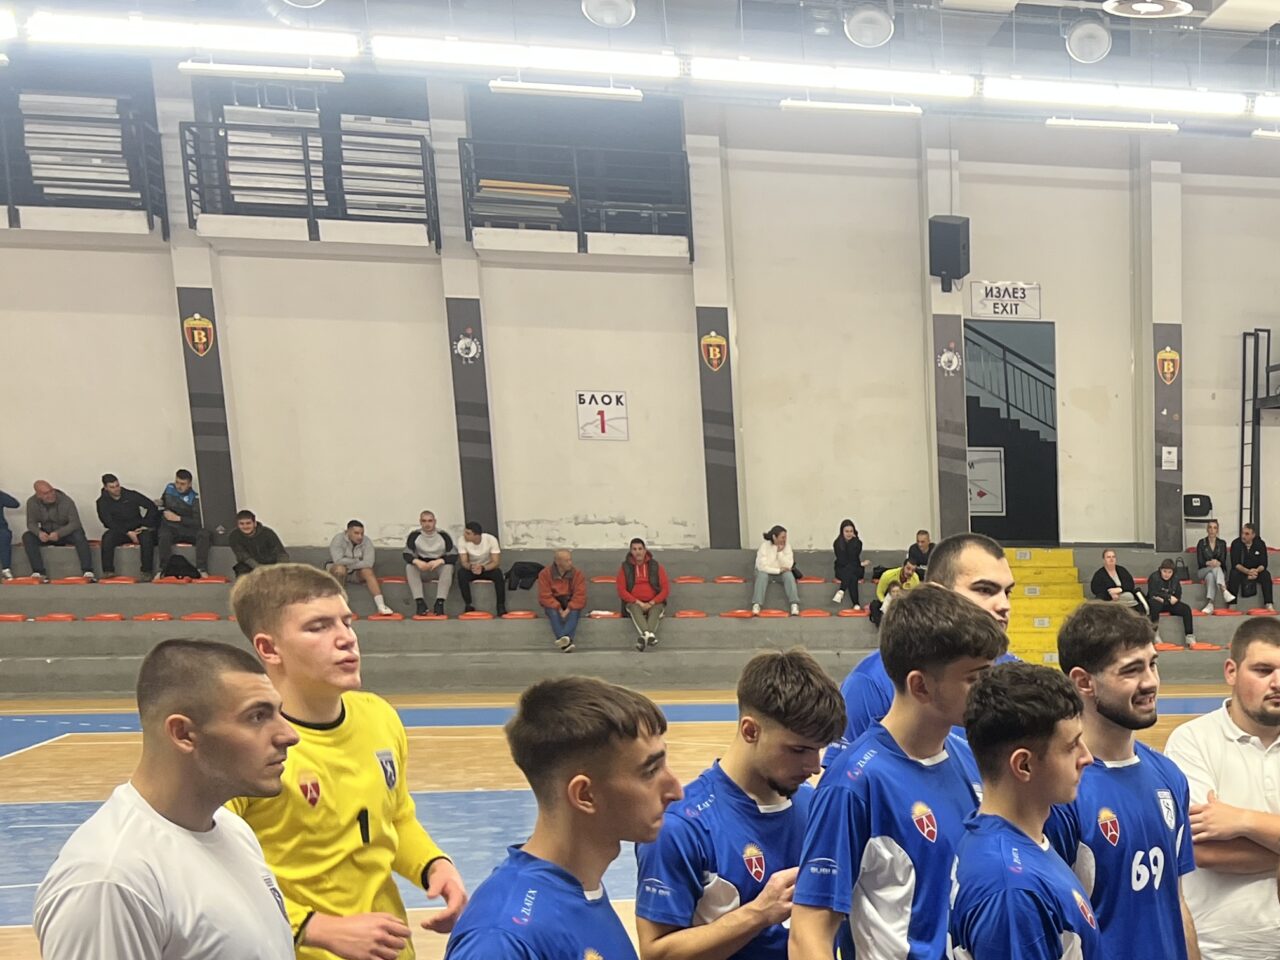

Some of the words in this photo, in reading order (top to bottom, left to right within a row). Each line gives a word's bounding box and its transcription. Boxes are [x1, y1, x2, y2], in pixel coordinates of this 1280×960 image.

[985, 286, 1026, 299] ИЗЛЕЗ
[993, 302, 1020, 315] EXIT
[578, 393, 625, 406] БЛОК
[596, 409, 606, 434] 1
[356, 807, 370, 844] 1
[1131, 846, 1164, 891] 69
[520, 889, 538, 916] ZLATEX
